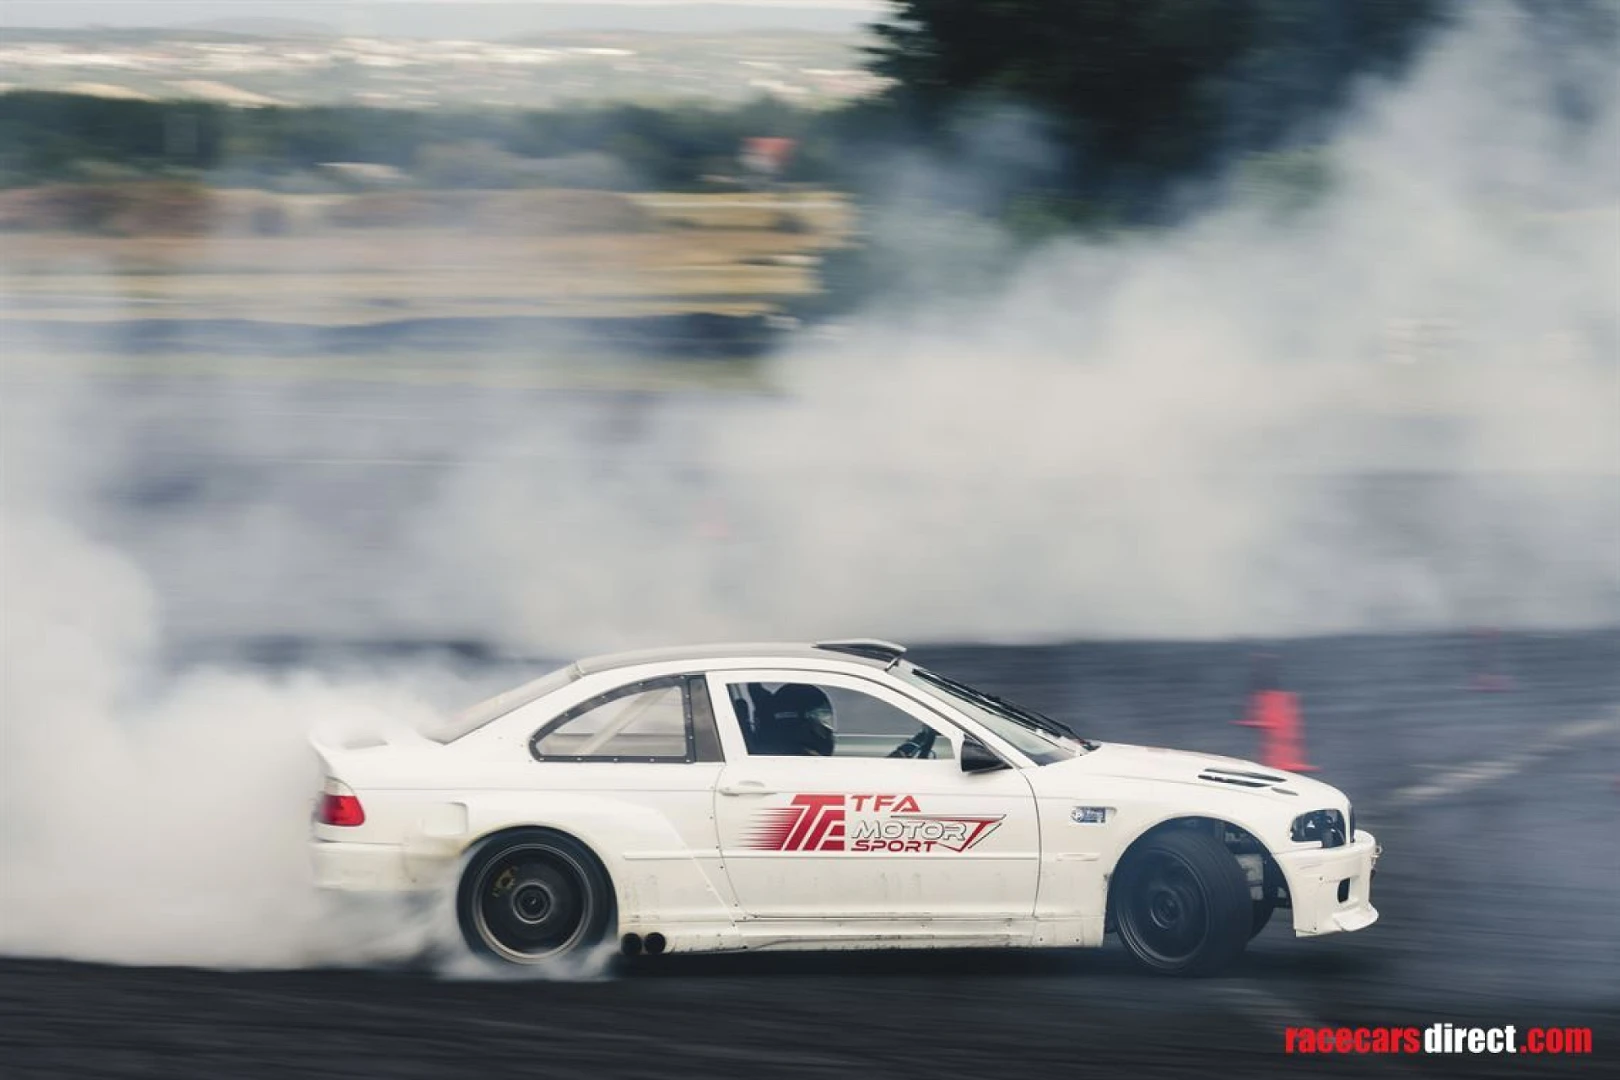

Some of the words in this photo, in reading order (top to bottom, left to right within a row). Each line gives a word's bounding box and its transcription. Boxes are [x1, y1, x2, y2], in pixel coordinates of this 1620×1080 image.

[850, 795, 921, 812] TFA
[851, 819, 967, 841] MOTOR
[850, 840, 938, 852] SPORT
